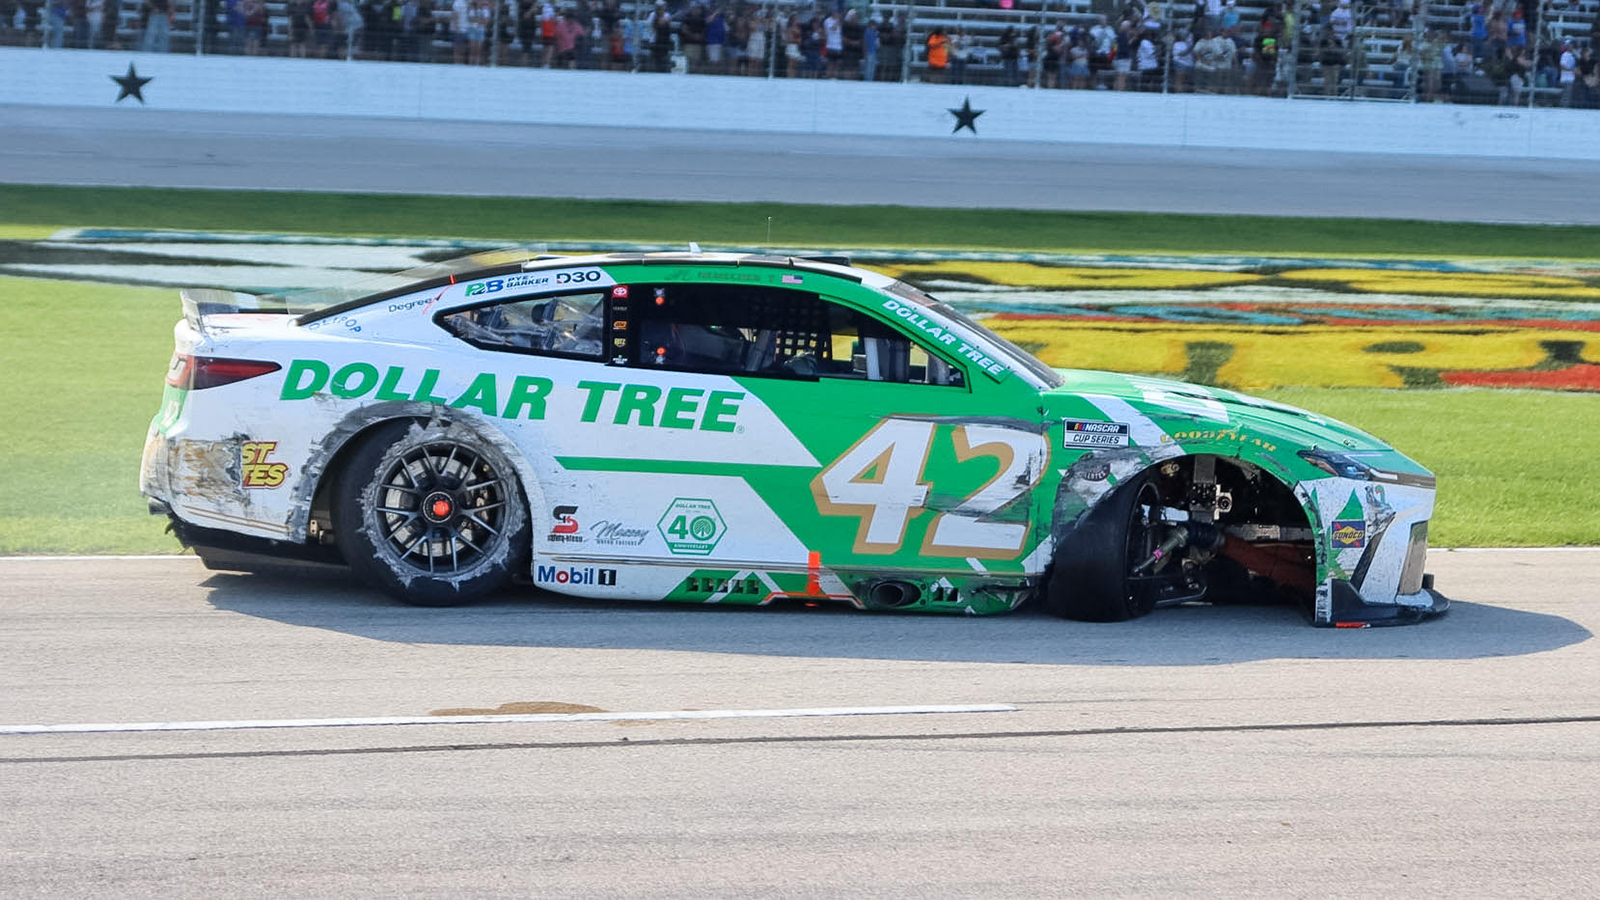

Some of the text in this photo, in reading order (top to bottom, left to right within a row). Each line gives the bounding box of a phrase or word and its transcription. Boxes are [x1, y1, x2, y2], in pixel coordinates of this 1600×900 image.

[506, 277, 549, 288] BARKER
[388, 297, 433, 313] Degree
[881, 300, 957, 345] DOLLAR
[957, 342, 1005, 375] TREE
[279, 359, 745, 434] DOLLAR TREE
[1085, 423, 1120, 433] NASCAR
[1073, 433, 1120, 444] CUP SERIES
[809, 412, 1052, 561] 42
[1332, 530, 1365, 541] SUNOCO
[537, 565, 594, 585] Mobil
